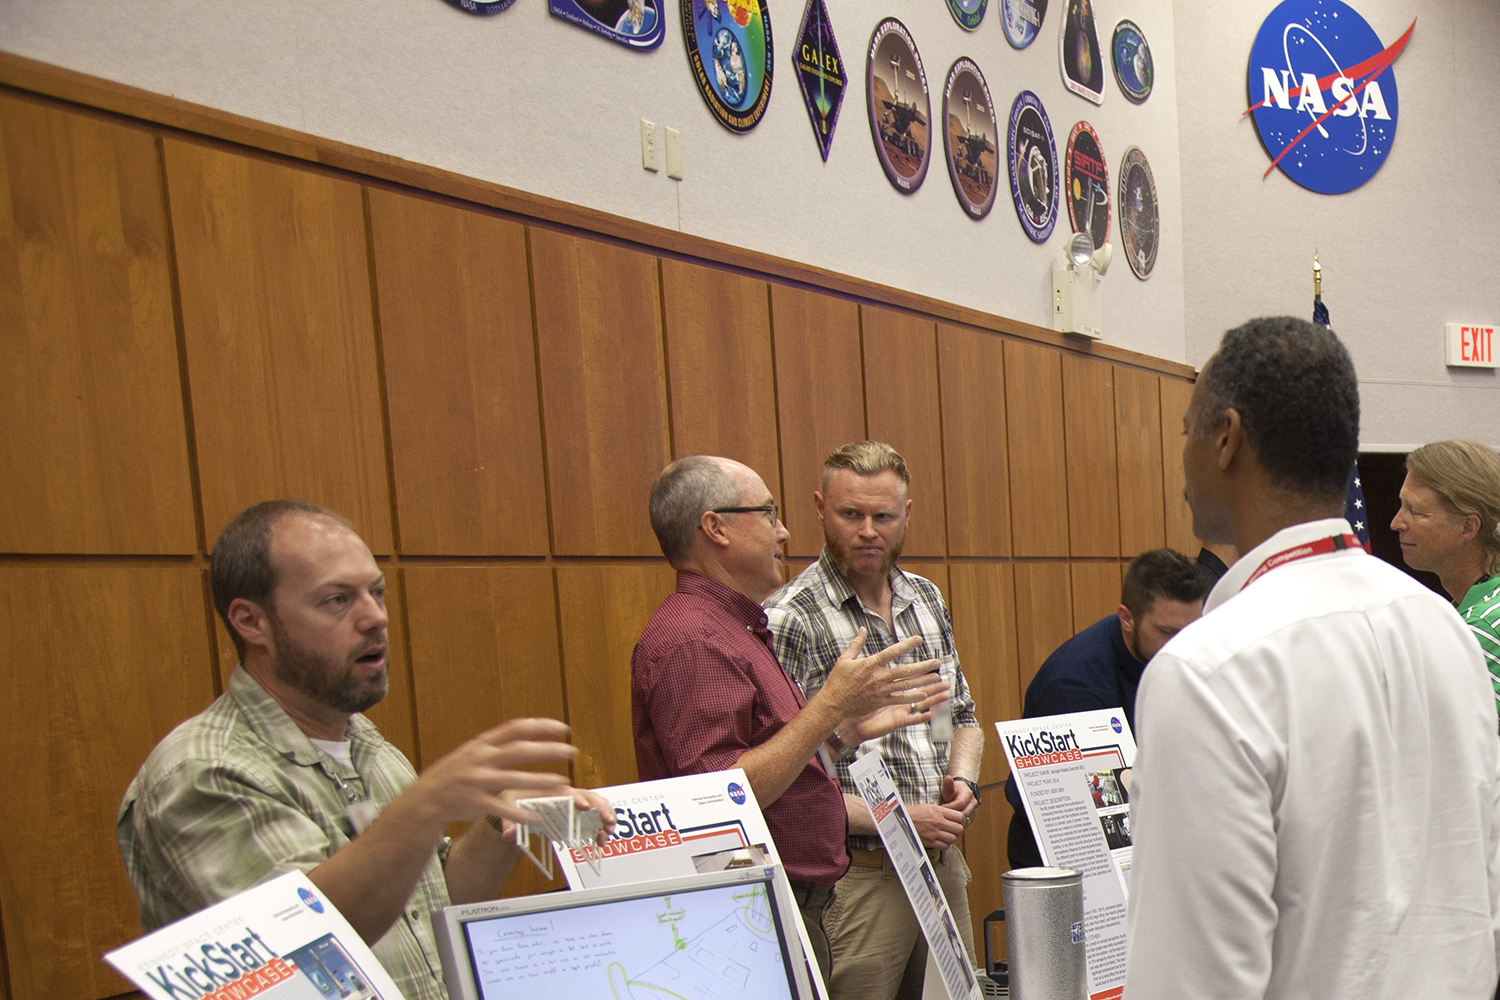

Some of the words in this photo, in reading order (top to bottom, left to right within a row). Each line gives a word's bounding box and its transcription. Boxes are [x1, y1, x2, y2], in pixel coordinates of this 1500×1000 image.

[871, 32, 881, 60] MARS
[881, 21, 915, 51] EXPLORATION
[802, 44, 838, 75] GALEX
[694, 54, 706, 86] SOLAR
[728, 114, 738, 126] AND
[946, 73, 954, 99] MARS
[954, 60, 984, 86] EXPLORATION
[1261, 67, 1392, 121] NASA
[1074, 150, 1103, 175] SIRTF
[1461, 326, 1494, 363] EXIT
[1051, 722, 1073, 730] CENTER
[1006, 729, 1080, 759] KickStart
[1016, 750, 1081, 768] SHOWCASE
[632, 794, 665, 805] CENTER
[729, 790, 745, 799] NASA
[573, 832, 679, 862] SHOWCASE
[461, 906, 499, 916] FLATRON
[182, 931, 213, 951] SPACE
[212, 916, 245, 940] CENTER
